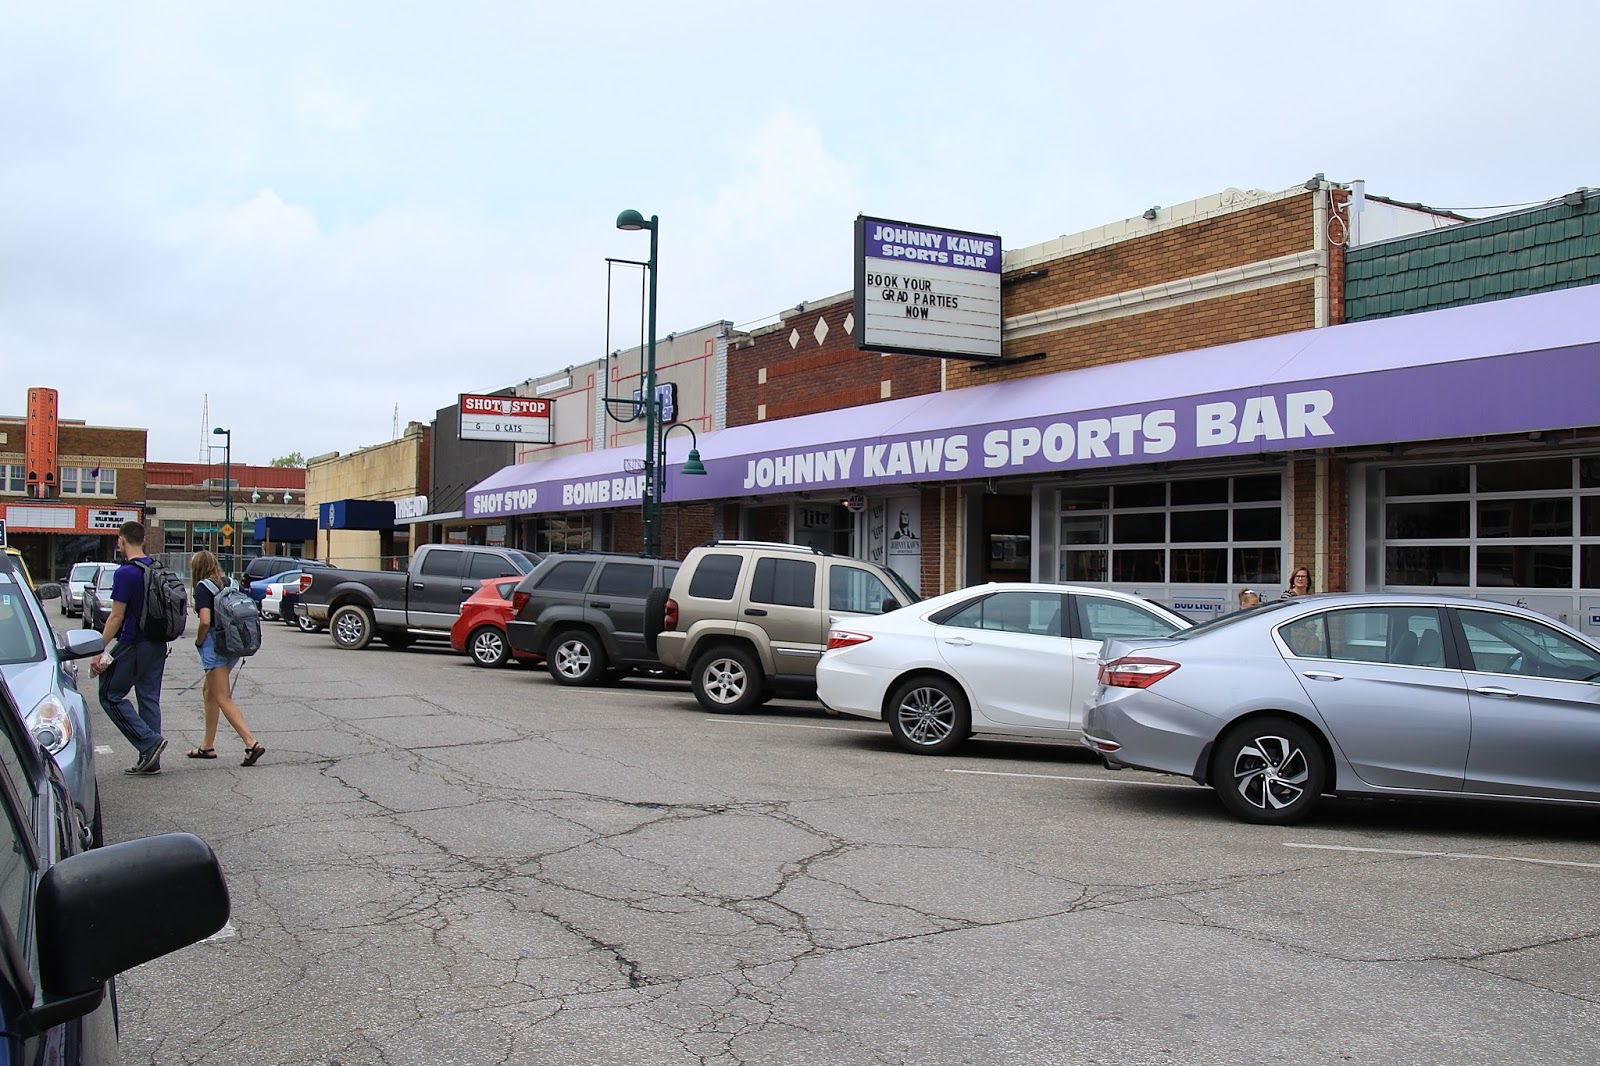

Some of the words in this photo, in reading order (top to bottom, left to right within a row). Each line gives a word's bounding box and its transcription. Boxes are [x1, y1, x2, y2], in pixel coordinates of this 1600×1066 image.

[873, 225, 943, 249] JOHNNY
[946, 236, 994, 257] KAWS
[881, 244, 949, 264] SPORTS
[952, 253, 987, 269] BAR
[867, 273, 898, 288] BOOK
[903, 277, 932, 292] YOUR
[882, 289, 908, 303] GRAD
[914, 293, 958, 309] PARTIES
[905, 306, 929, 319] NOW
[465, 398, 500, 411] SHOT
[512, 401, 546, 413] STOP
[46, 393, 54, 470] RALLY
[504, 424, 522, 432] CATS
[743, 447, 857, 489] JOHNNY
[863, 434, 969, 478] KAWS
[983, 409, 1177, 469] SPORTS
[1196, 389, 1335, 447] BAR
[473, 493, 503, 514] SHOT
[504, 488, 538, 512] STOP
[562, 480, 611, 506] BOMB
[801, 507, 830, 528] Lite
